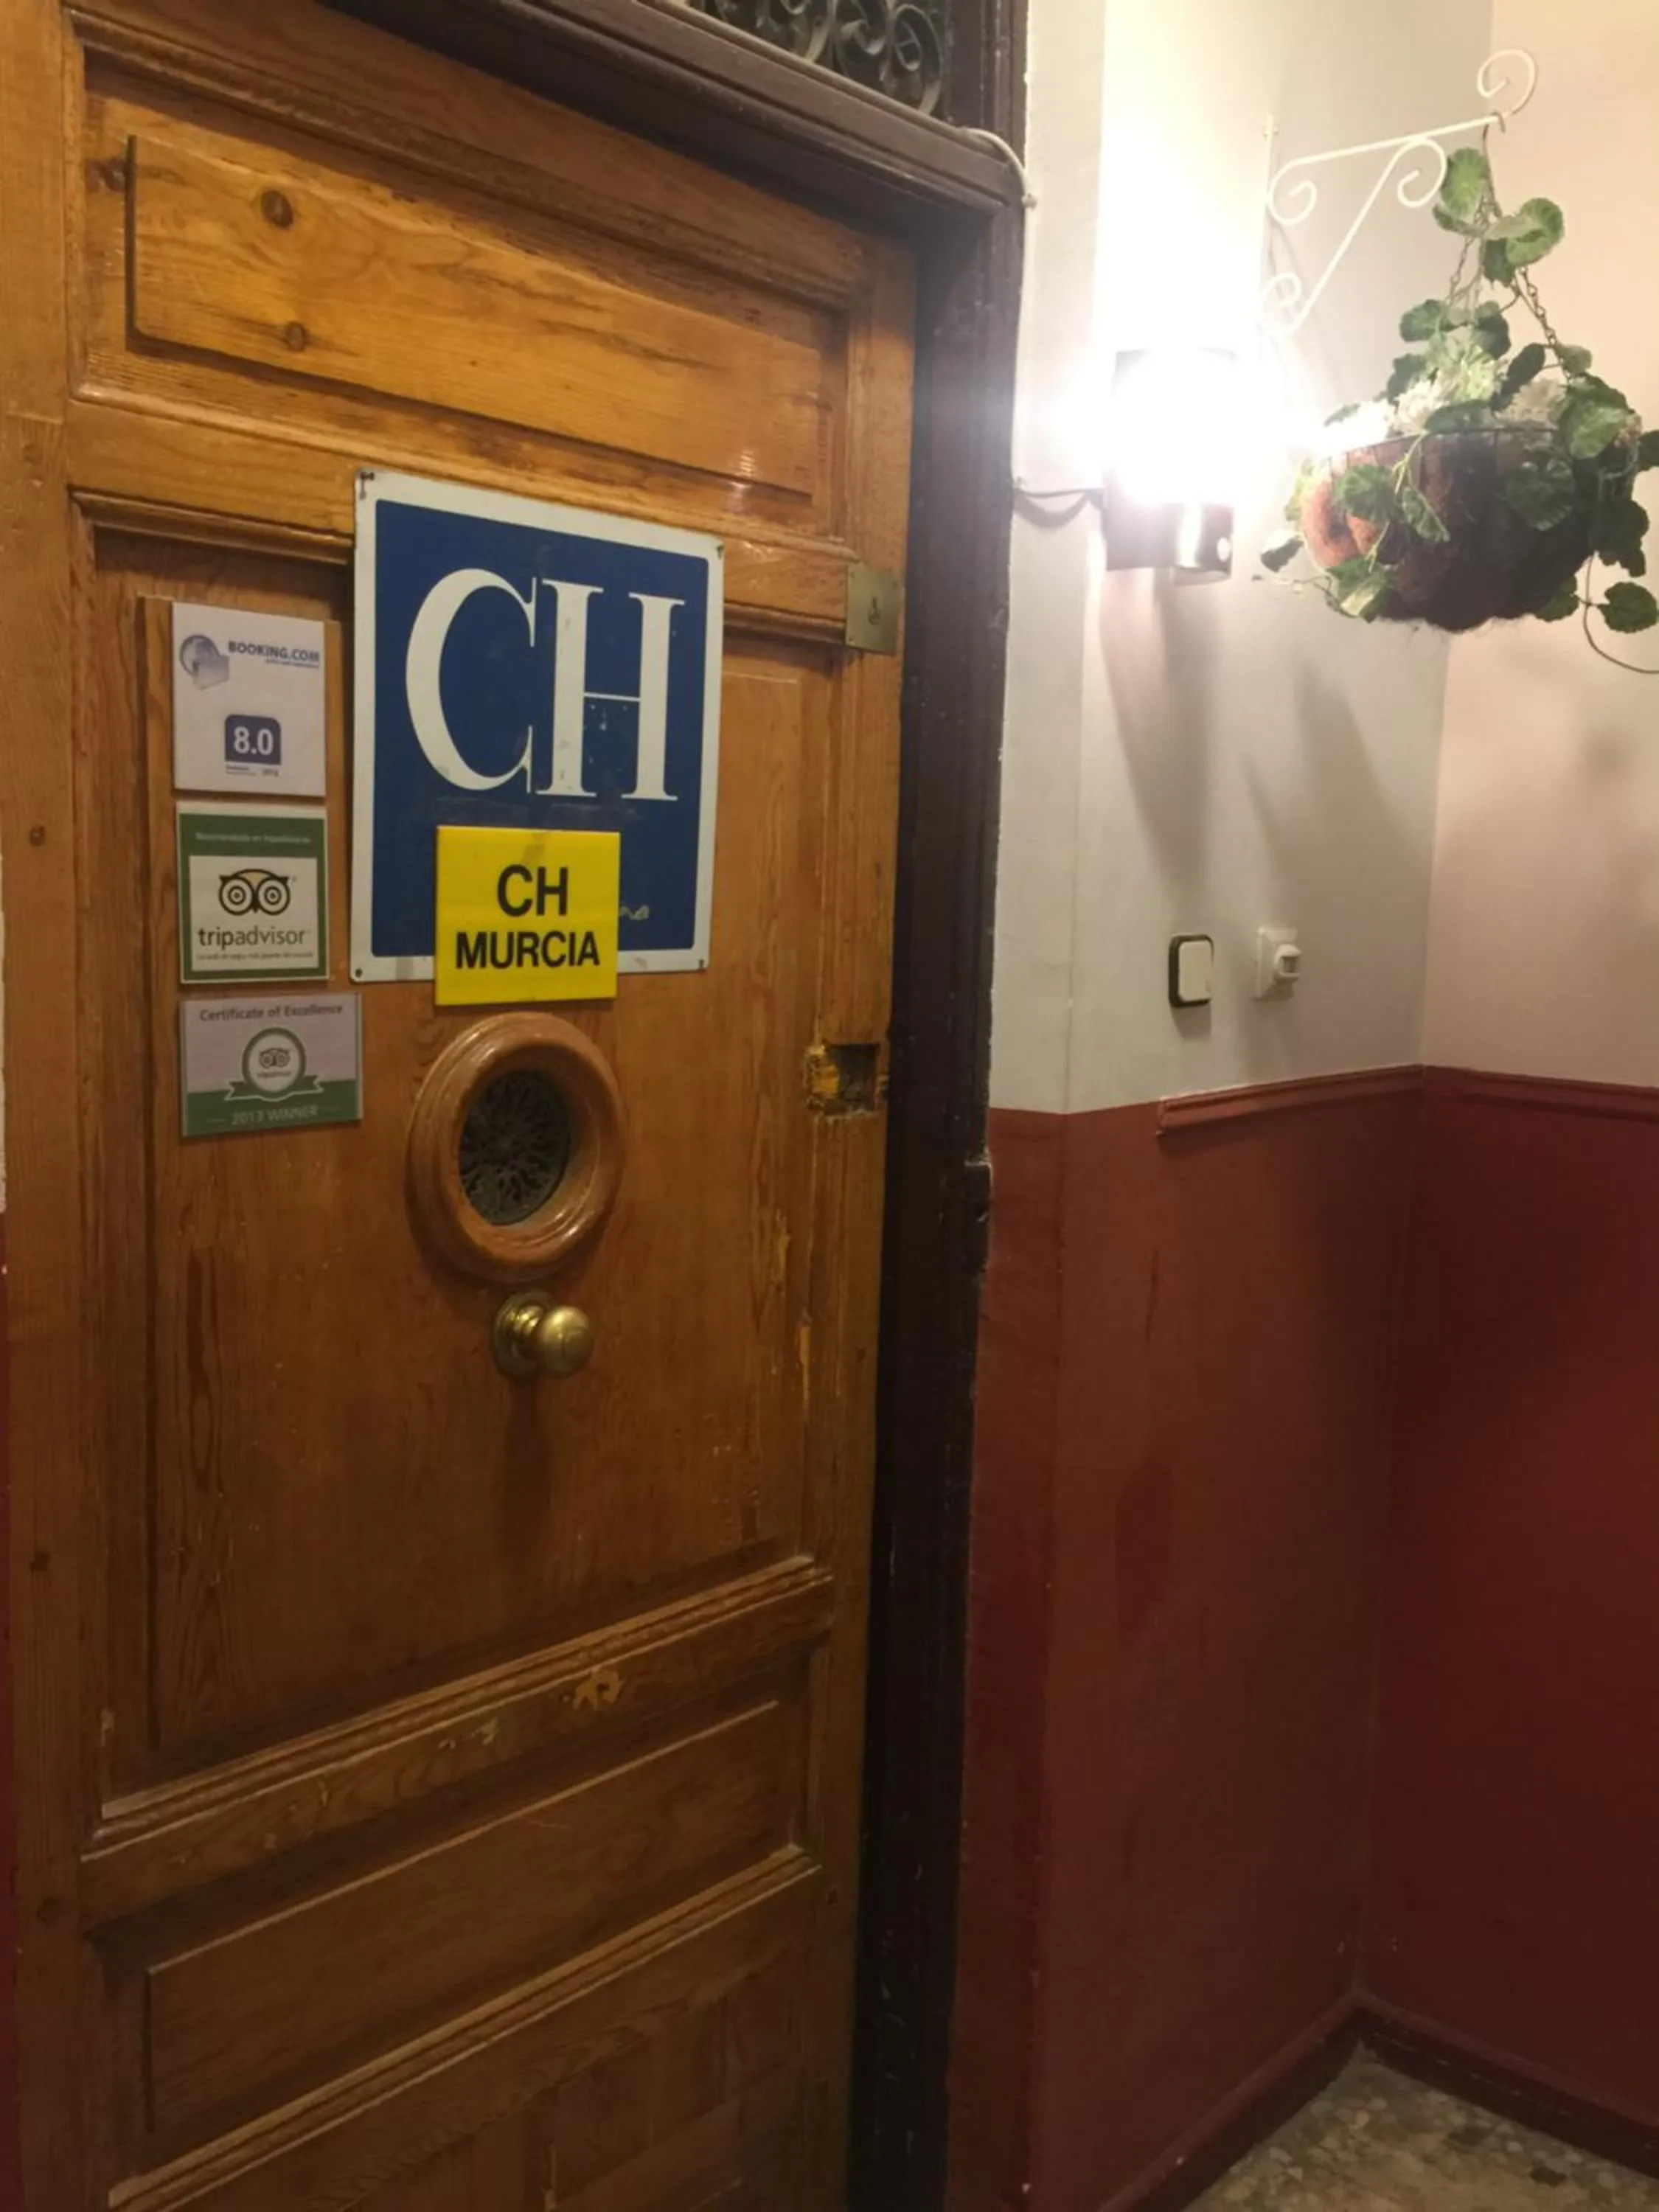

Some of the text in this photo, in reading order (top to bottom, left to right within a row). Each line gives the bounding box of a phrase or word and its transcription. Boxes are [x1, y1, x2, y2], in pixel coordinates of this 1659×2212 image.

[228, 641, 319, 662] BOOKING.COM
[406, 568, 686, 801] CH
[234, 726, 274, 755] 8.0
[496, 864, 568, 917] CH
[198, 925, 306, 950] tripadvisor
[455, 931, 600, 969] MURCIA
[199, 1004, 343, 1021] Certificate of Excellence
[267, 1105, 318, 1121] WINNER
